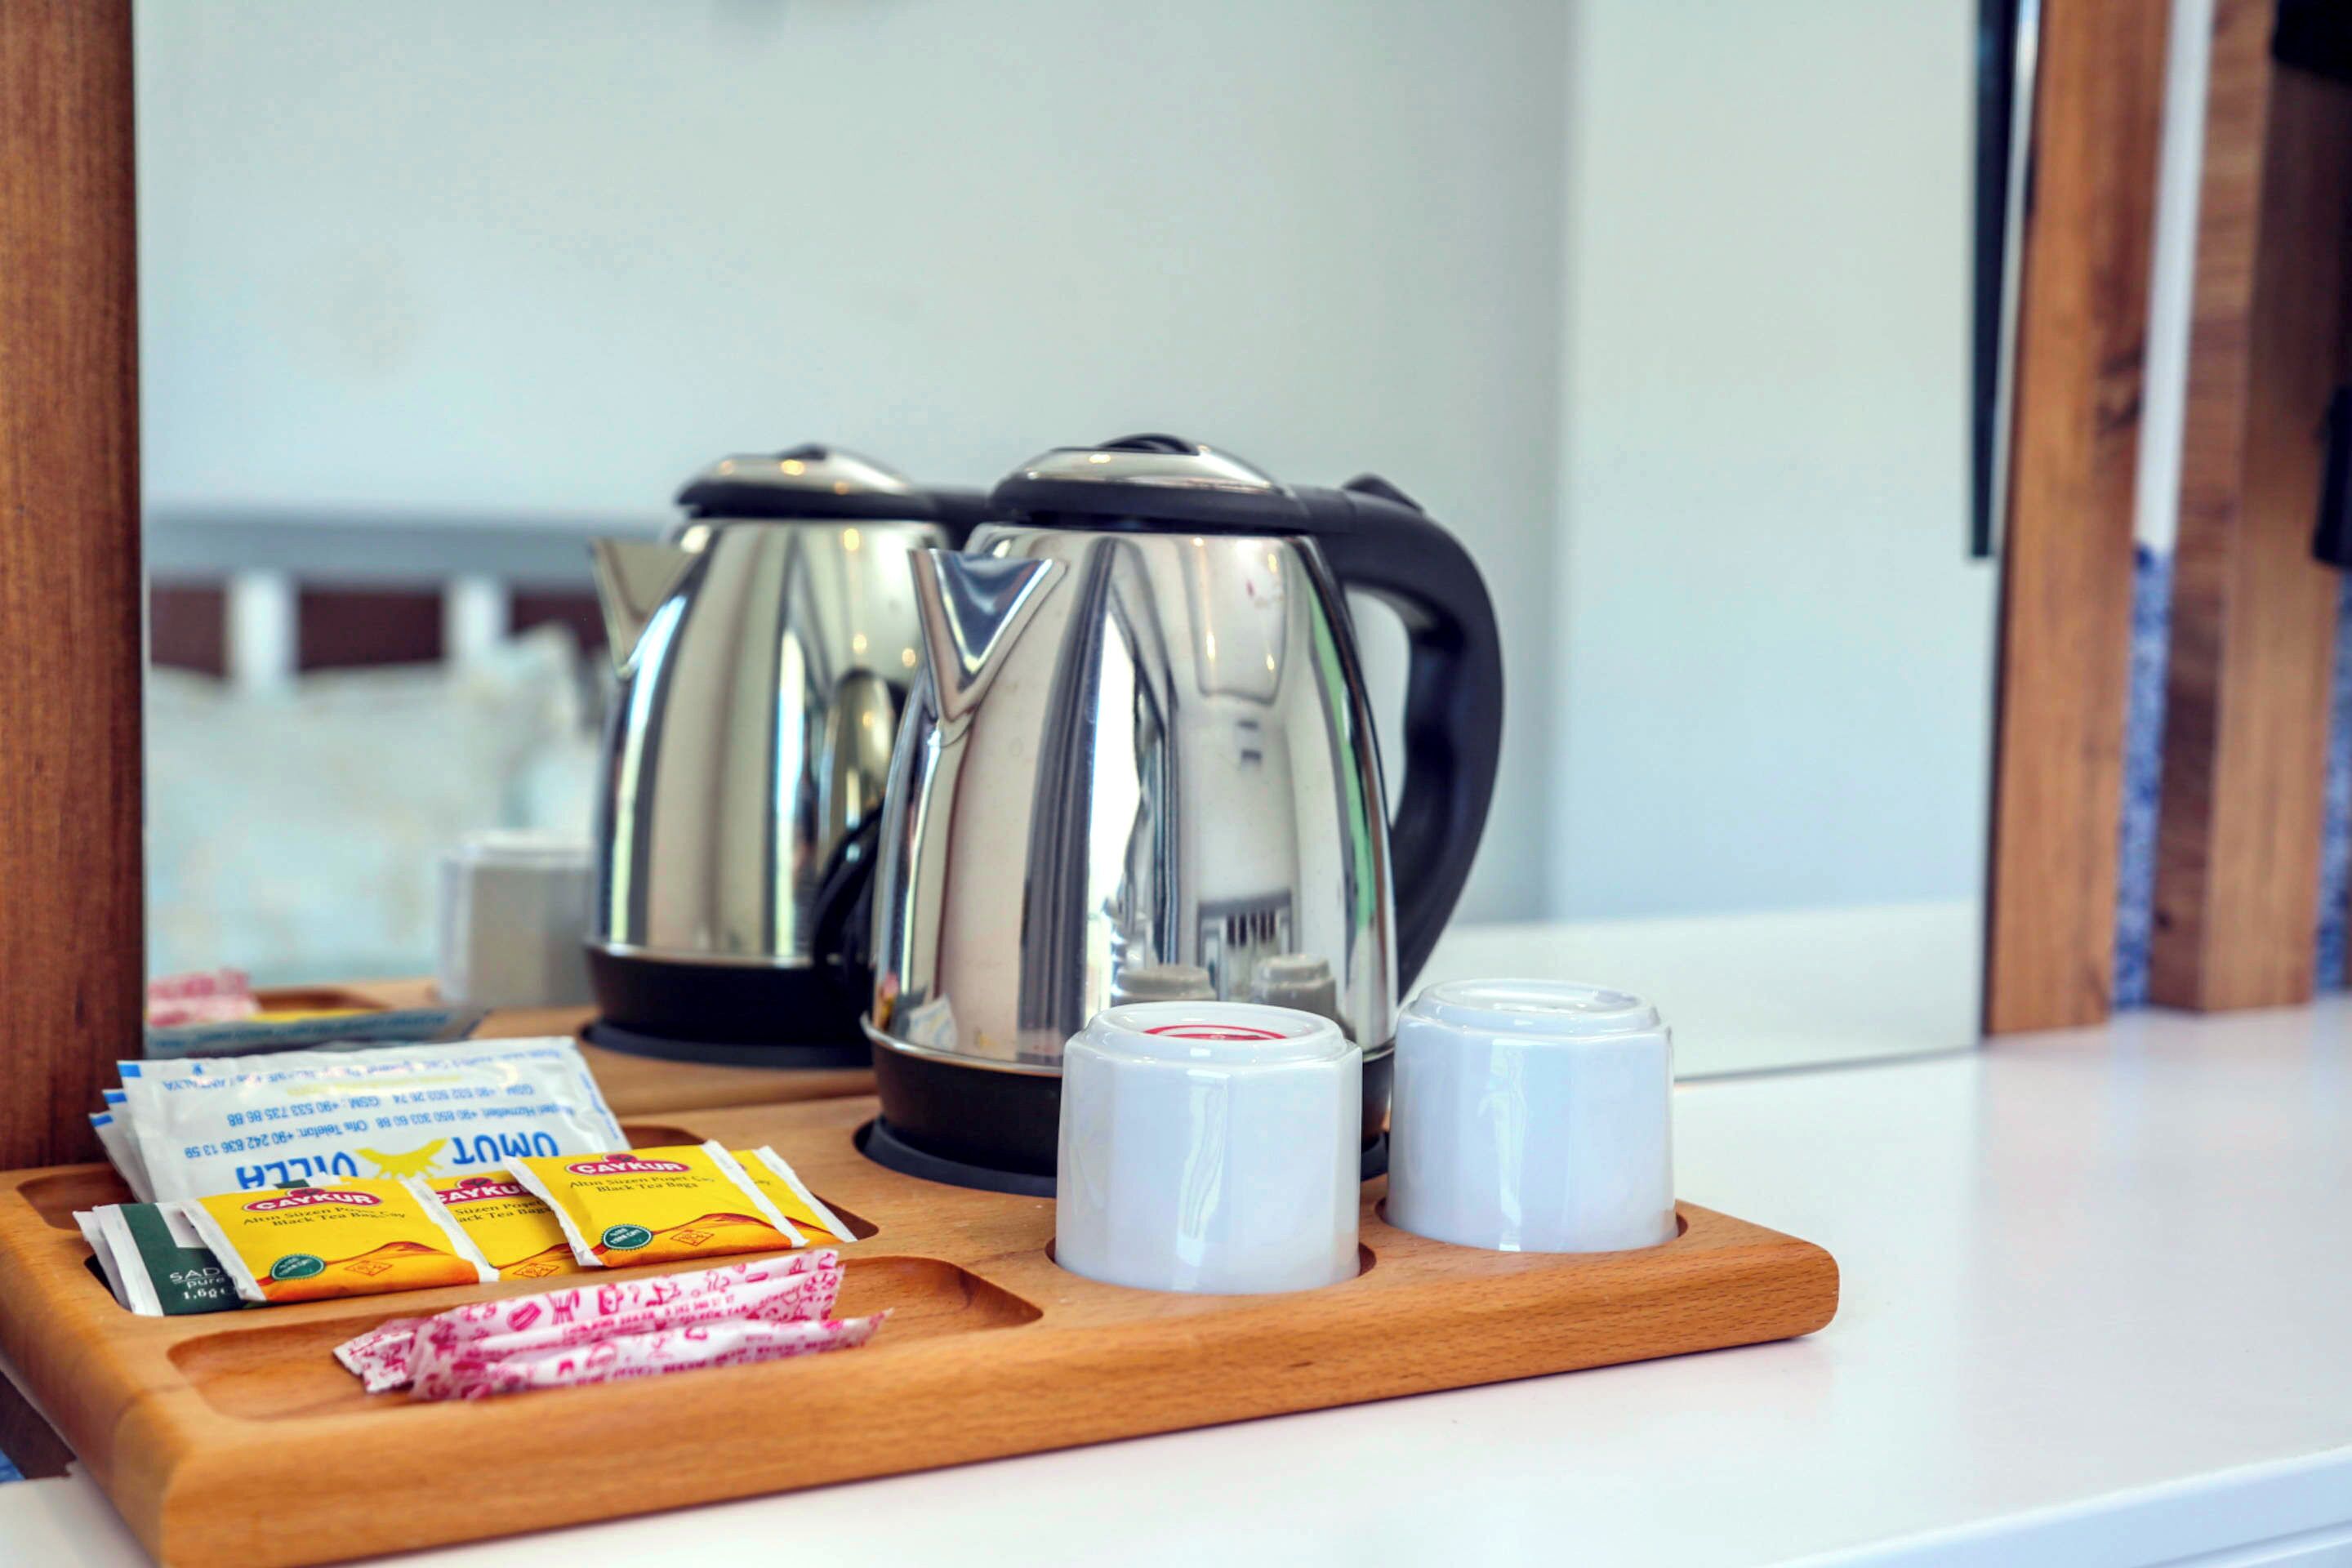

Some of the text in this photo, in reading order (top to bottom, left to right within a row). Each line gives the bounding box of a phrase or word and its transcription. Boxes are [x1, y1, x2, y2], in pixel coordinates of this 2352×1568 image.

[265, 1107, 288, 1120] 735
[291, 1104, 314, 1117] 533
[316, 1100, 341, 1114] +90
[227, 1113, 243, 1126] 88
[411, 1113, 431, 1125] 303
[457, 1108, 478, 1120] +90
[344, 1120, 368, 1133] Ofis
[247, 1134, 269, 1149] 242
[271, 1129, 295, 1144] +90
[184, 1145, 202, 1159] 59
[203, 1144, 217, 1156] 13
[221, 1138, 243, 1153] 836
[452, 1131, 560, 1165] UMUT
[577, 1160, 684, 1174] ÇAYKUR
[596, 1183, 635, 1193] Black
[666, 1181, 699, 1191] Bags
[455, 1205, 499, 1216] Süzen
[490, 1210, 514, 1220] Tea
[519, 1206, 554, 1217] Bags
[272, 1215, 314, 1226] Black
[320, 1213, 347, 1222] Tea
[186, 1276, 225, 1290] pure
